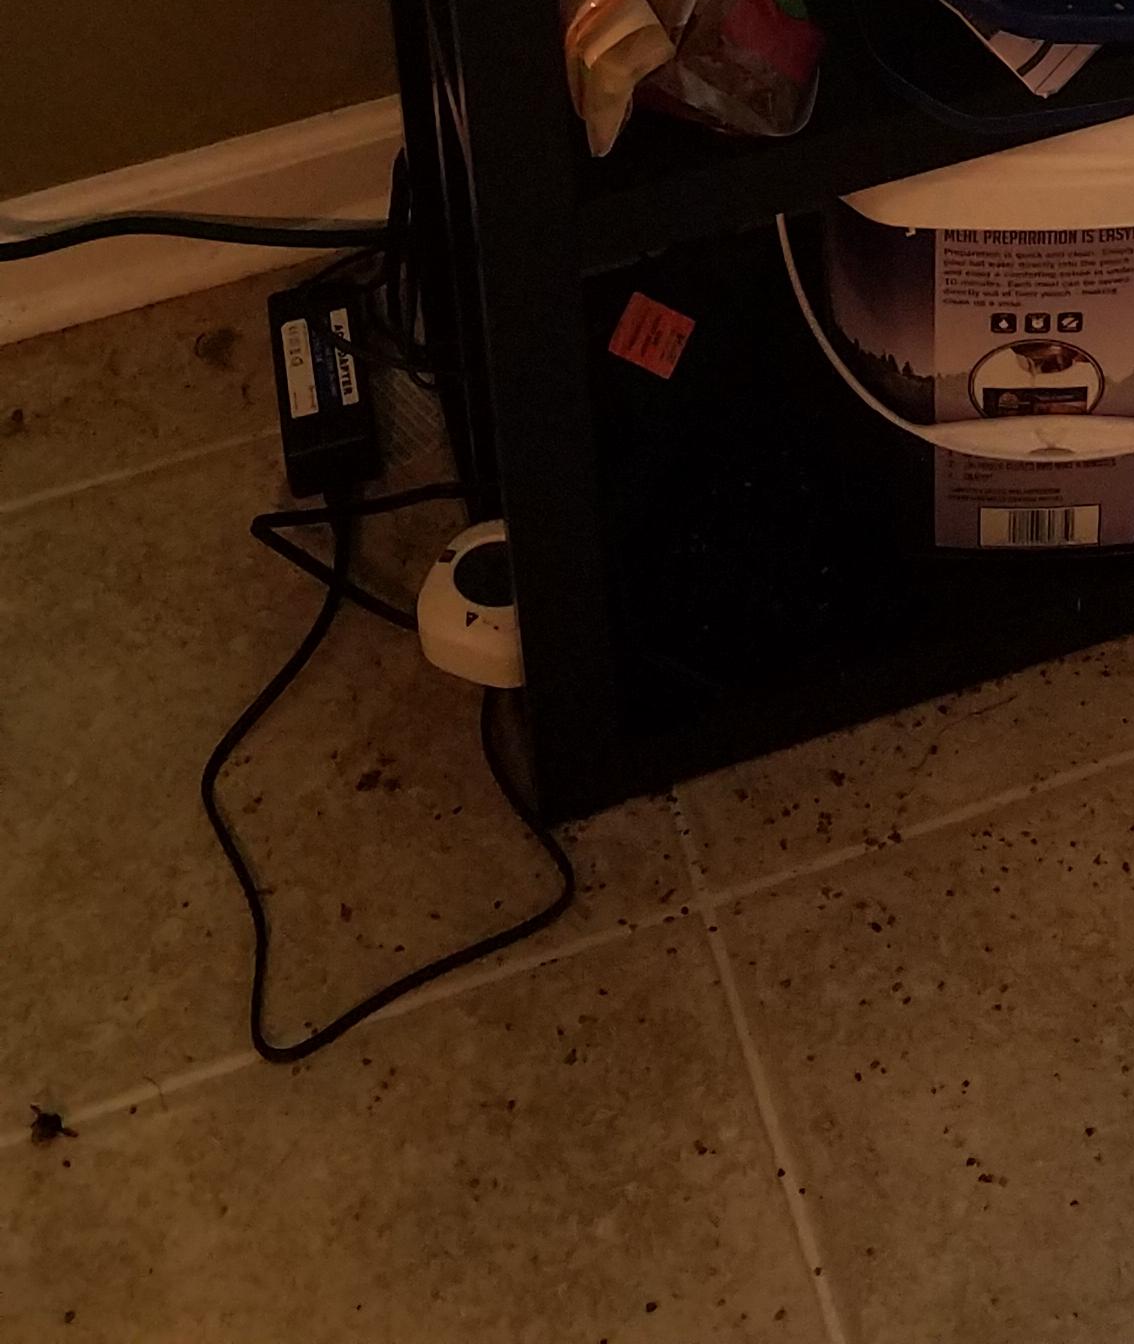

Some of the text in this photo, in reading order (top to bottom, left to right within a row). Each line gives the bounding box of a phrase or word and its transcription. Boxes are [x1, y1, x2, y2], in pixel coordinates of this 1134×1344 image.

[944, 229, 979, 243] MEAL
[984, 230, 1076, 245] PREPARATION
[1082, 229, 1094, 243] IS
